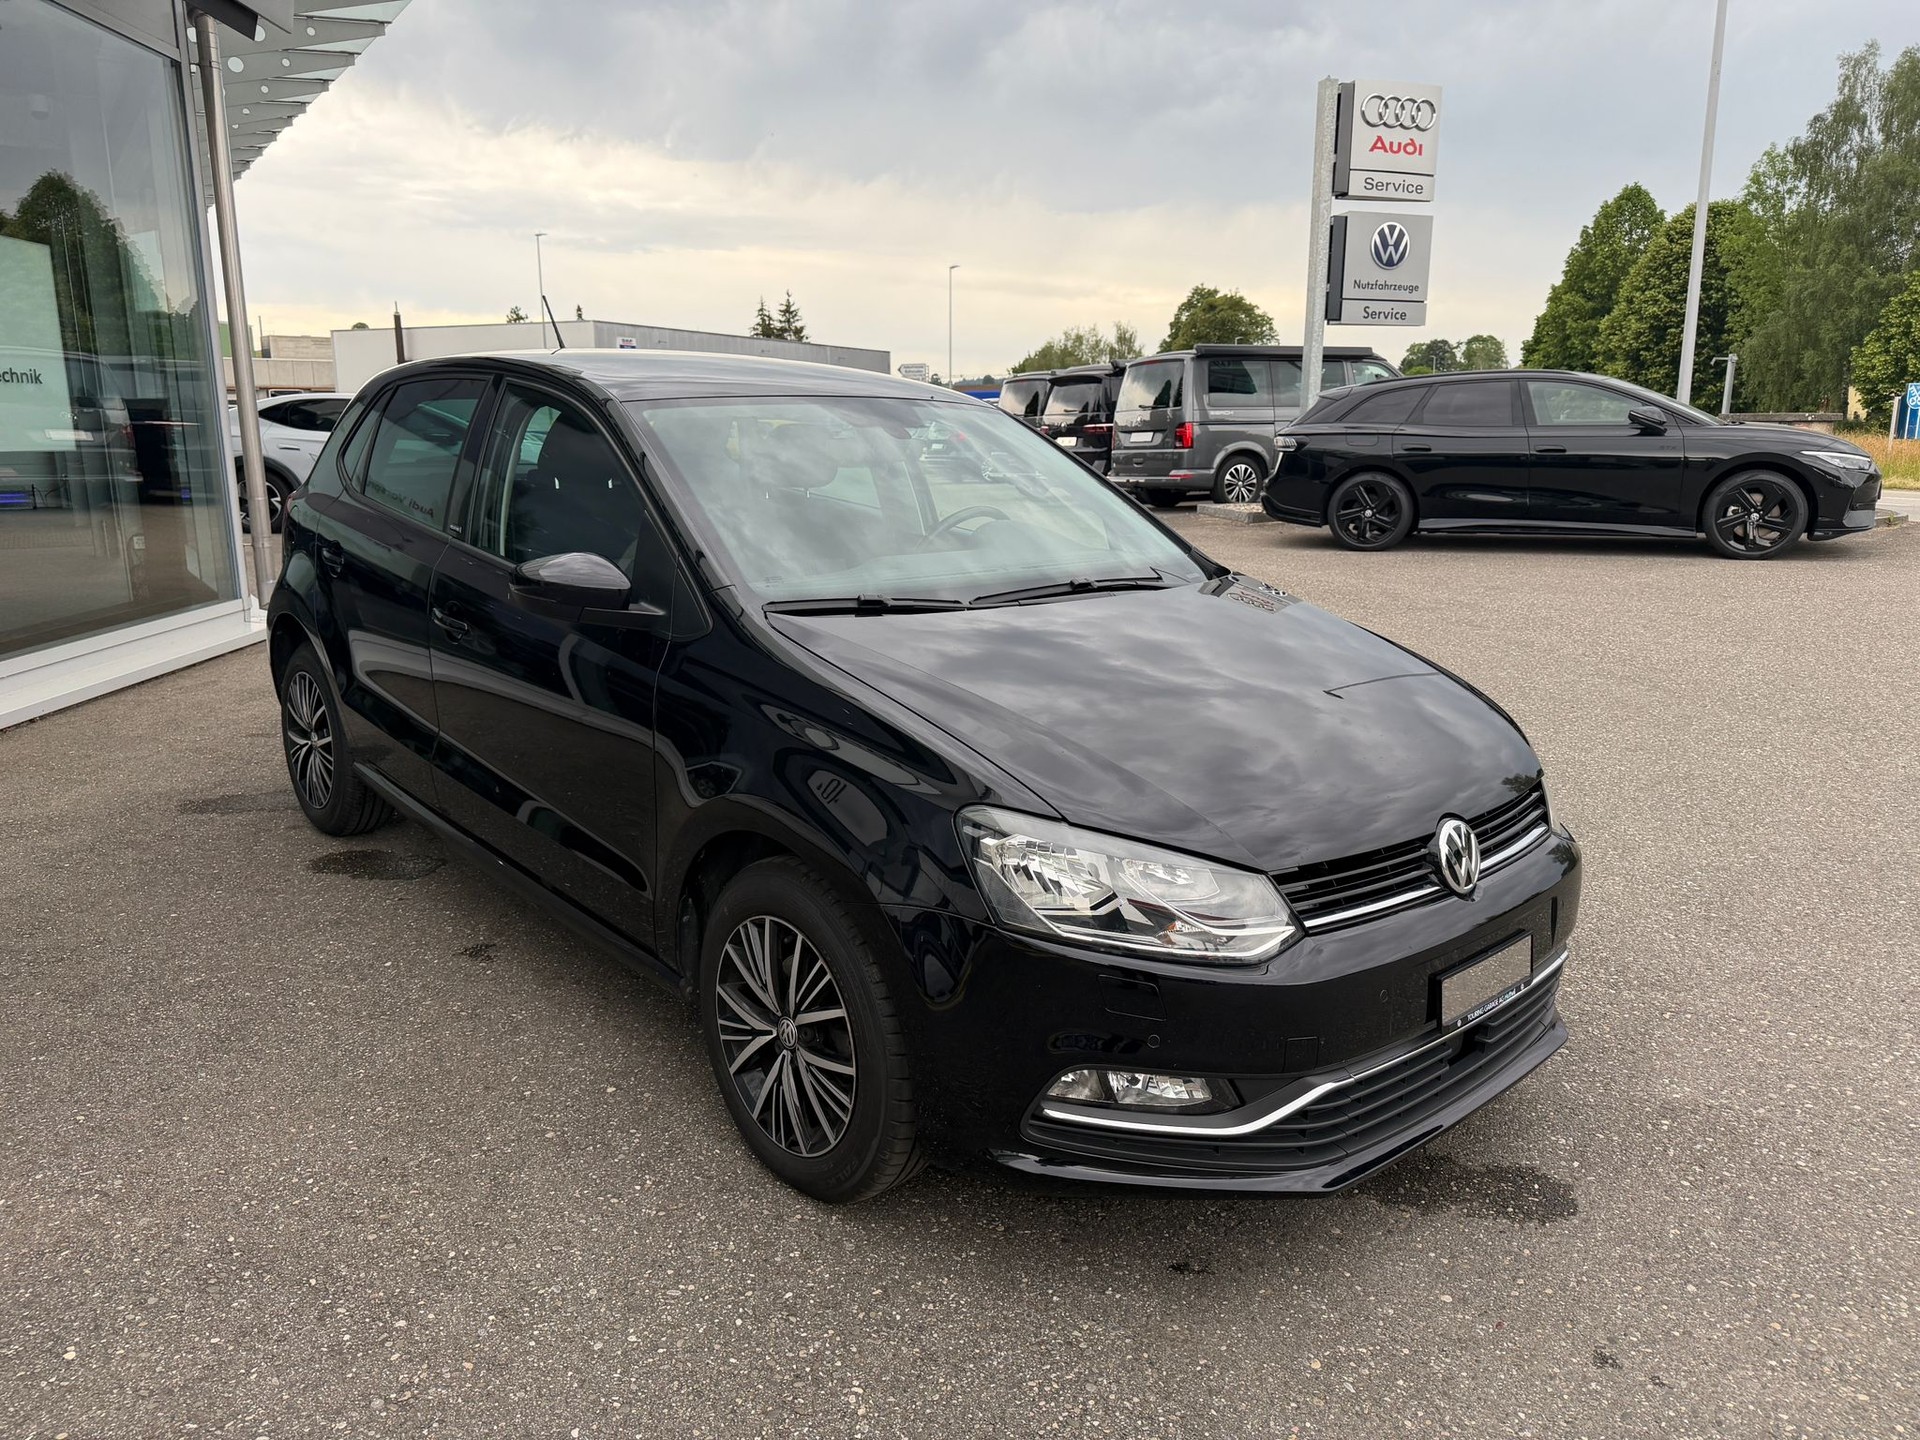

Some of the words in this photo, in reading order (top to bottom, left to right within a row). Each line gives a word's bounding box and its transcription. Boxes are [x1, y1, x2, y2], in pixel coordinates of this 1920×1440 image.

[1369, 135, 1424, 157] Audi
[1363, 177, 1424, 195] Service
[1353, 279, 1420, 293] Nutzfahrzeuge
[1363, 306, 1407, 321] Service
[0, 367, 43, 385] chnik
